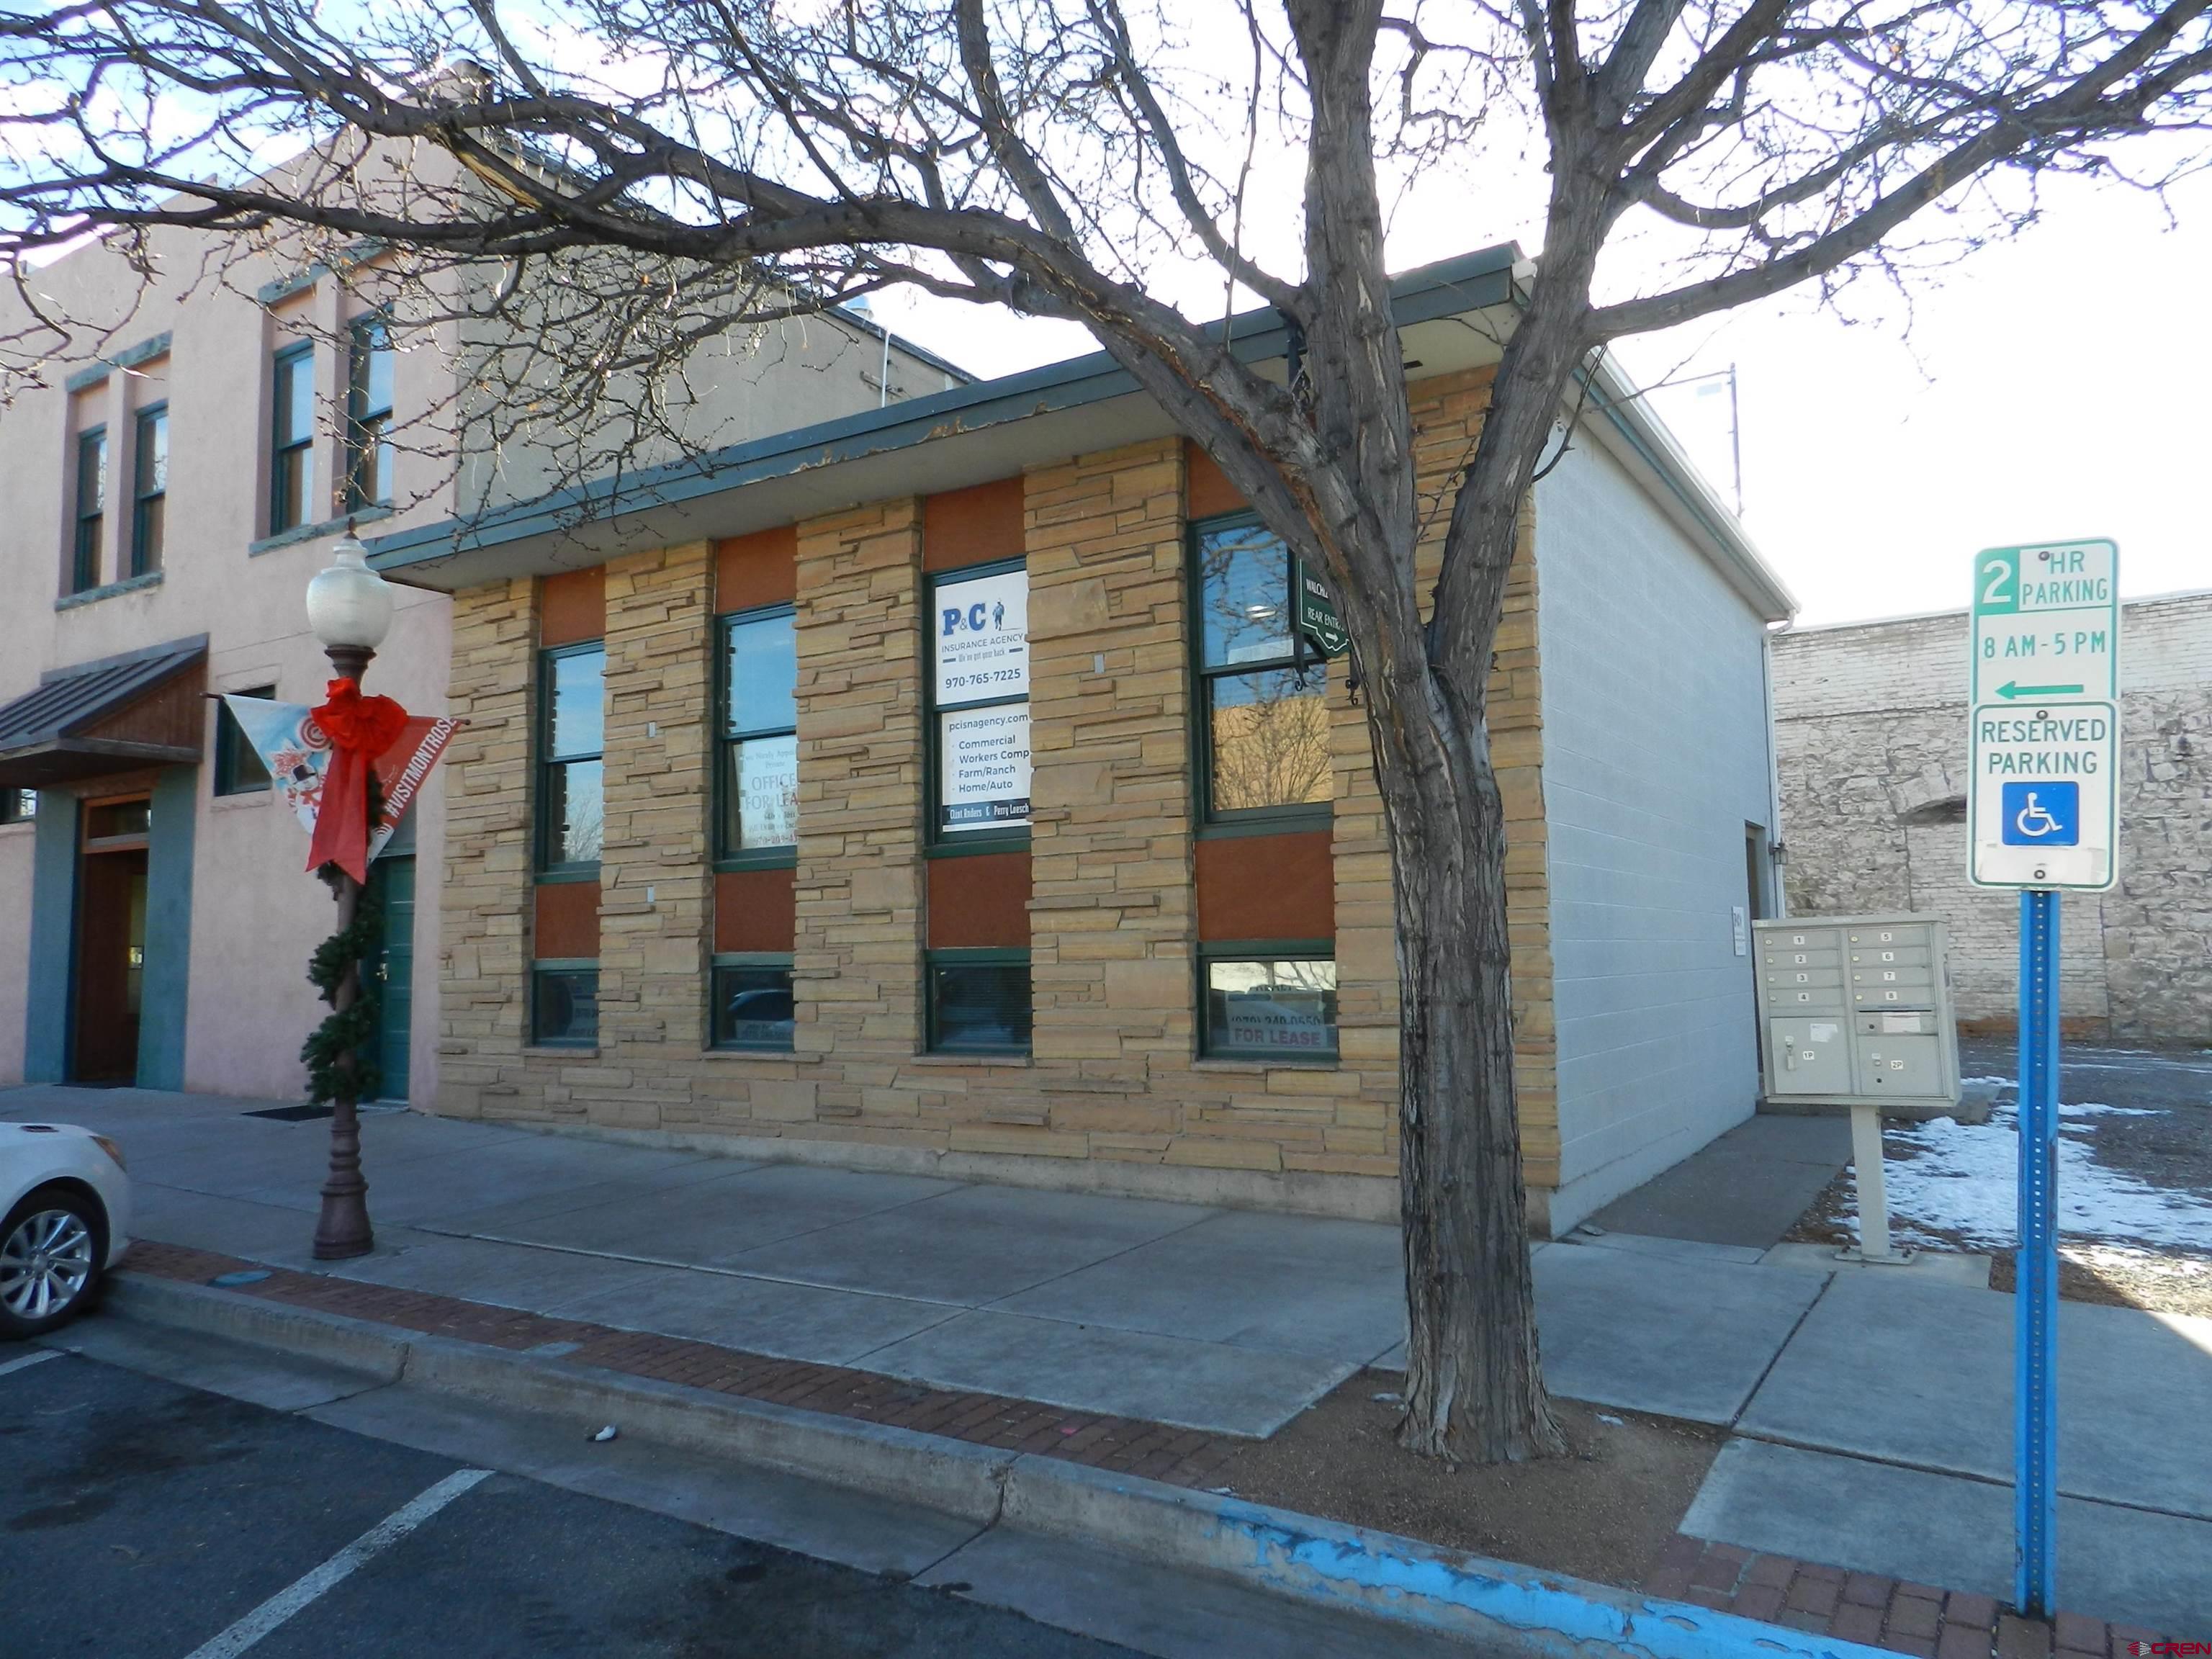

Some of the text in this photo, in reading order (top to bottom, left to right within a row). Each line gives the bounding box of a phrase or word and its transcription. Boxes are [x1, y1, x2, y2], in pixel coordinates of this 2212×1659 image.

[2050, 551, 2085, 575] HR
[1982, 559, 2011, 604] 2
[2022, 577, 2108, 605] PARKING
[942, 603, 986, 637] P&C
[1307, 606, 1323, 624] REAR
[942, 633, 1024, 654] INSURANCE AGENCY
[1984, 637, 1995, 659] 8
[2005, 634, 2036, 657] AM
[2074, 630, 2105, 655] PM
[945, 667, 1021, 689] 970-765-7225
[949, 714, 1028, 732] pcisnagency.com
[1982, 719, 2106, 743] RESERVED
[958, 734, 1015, 750] Commercial
[959, 750, 1030, 764] Workers Comp
[1988, 751, 2098, 775] PARKING
[958, 764, 1016, 778] Farm/Ranch
[752, 773, 796, 791] OFFICE
[958, 781, 1013, 793] Home/Auto
[745, 794, 770, 810] FOR
[994, 804, 1008, 817] Perry
[1234, 1028, 1321, 1046] FOR LEASE
